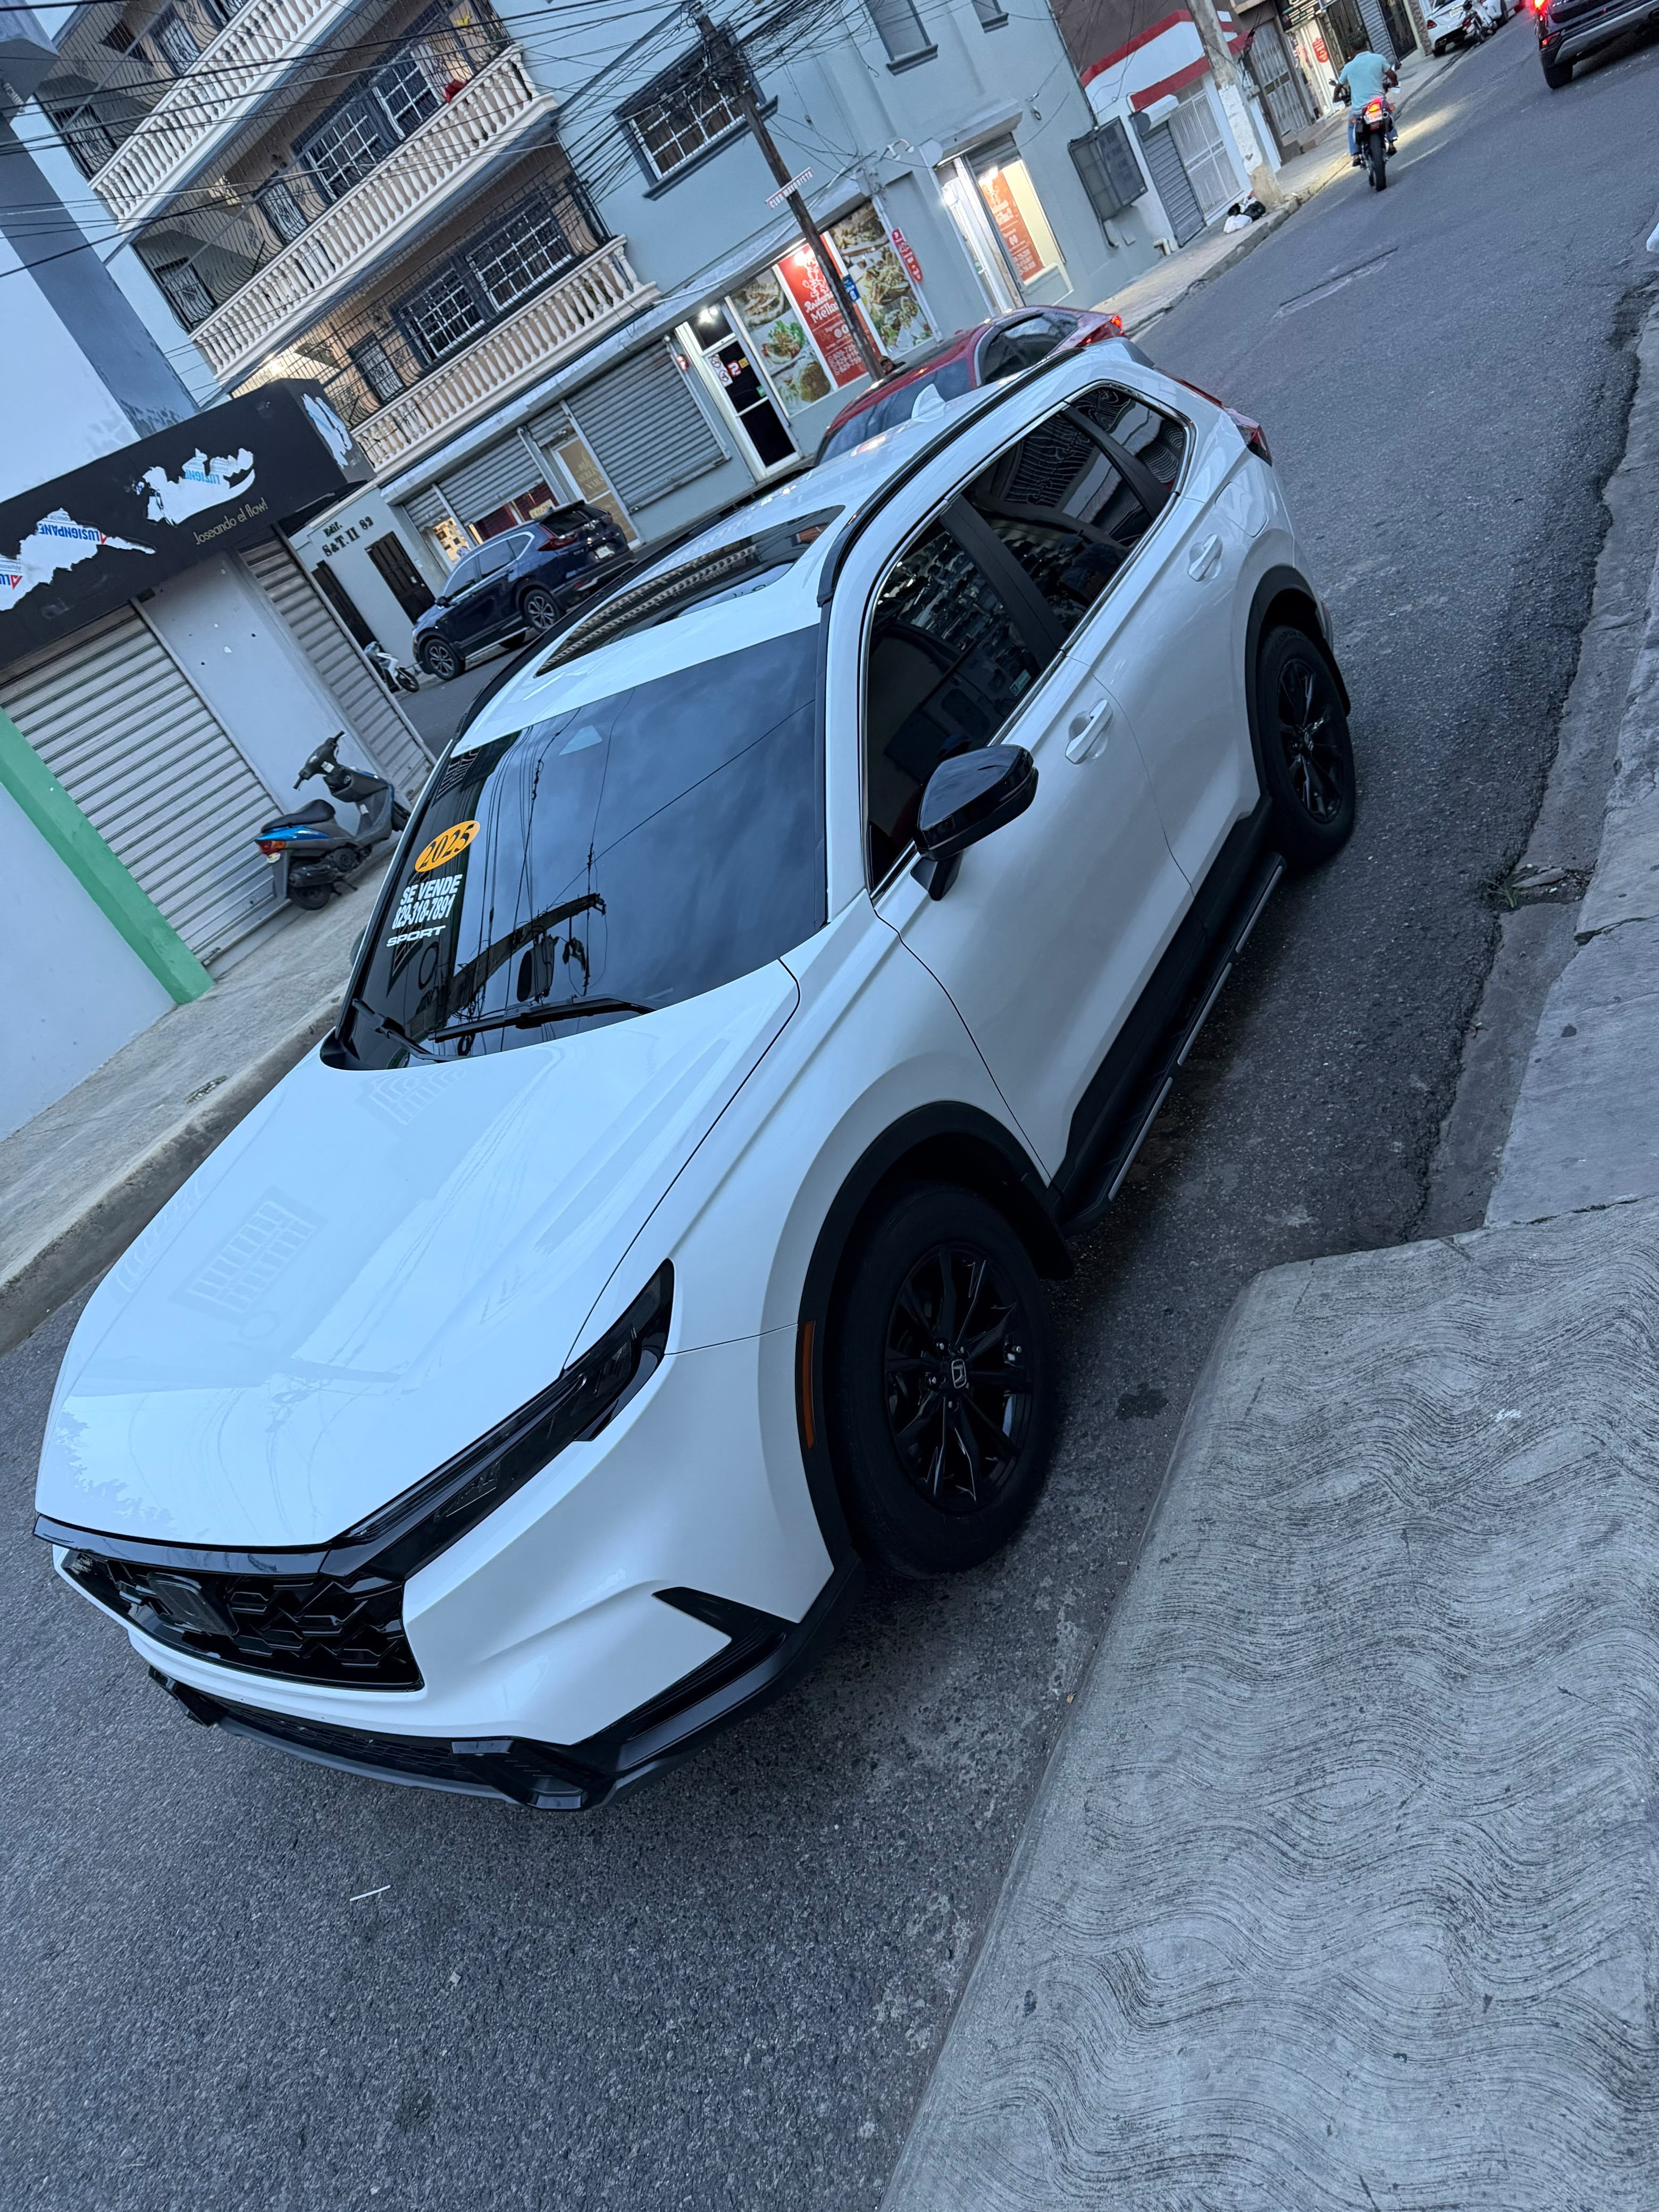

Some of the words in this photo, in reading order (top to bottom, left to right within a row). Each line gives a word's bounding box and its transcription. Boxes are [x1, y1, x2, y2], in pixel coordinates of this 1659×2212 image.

[193, 515, 237, 545] Joseando
[237, 507, 247, 523] el
[245, 497, 269, 518] flow!
[418, 822, 477, 870] 2025
[400, 884, 418, 906] SE
[417, 874, 463, 901] VENDE
[386, 925, 446, 948] SPORT
